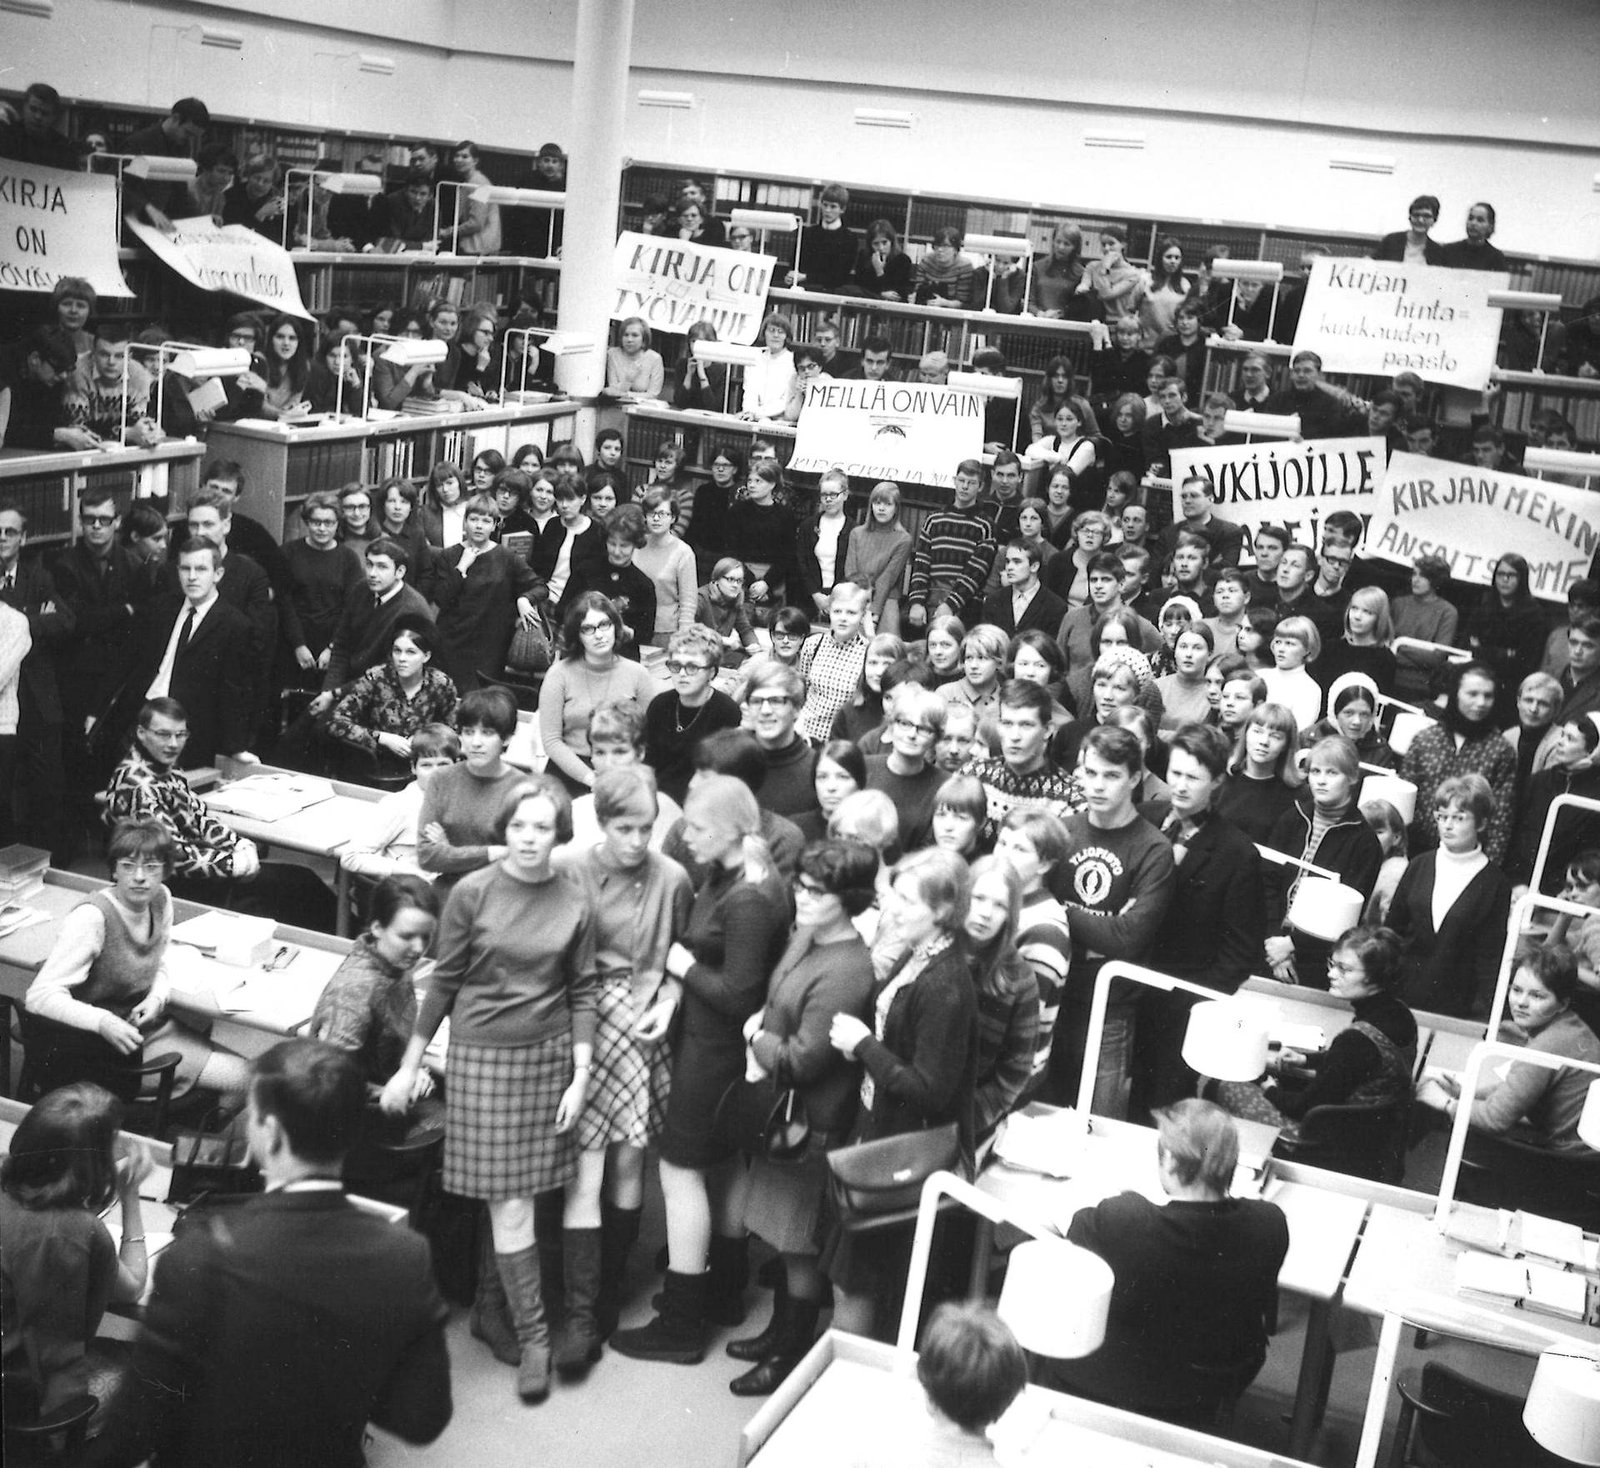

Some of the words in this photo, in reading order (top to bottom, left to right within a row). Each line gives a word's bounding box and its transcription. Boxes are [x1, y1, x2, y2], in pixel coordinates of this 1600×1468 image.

[16, 226, 46, 256] ON
[629, 244, 715, 286] KIRJA
[728, 264, 766, 297] ON
[1328, 264, 1407, 295] Kirjan
[1382, 350, 1457, 372] paasto
[808, 385, 886, 411] MEILLÄ
[1392, 477, 1499, 516] KIRJAN
[1503, 486, 1598, 557] MEKIN
